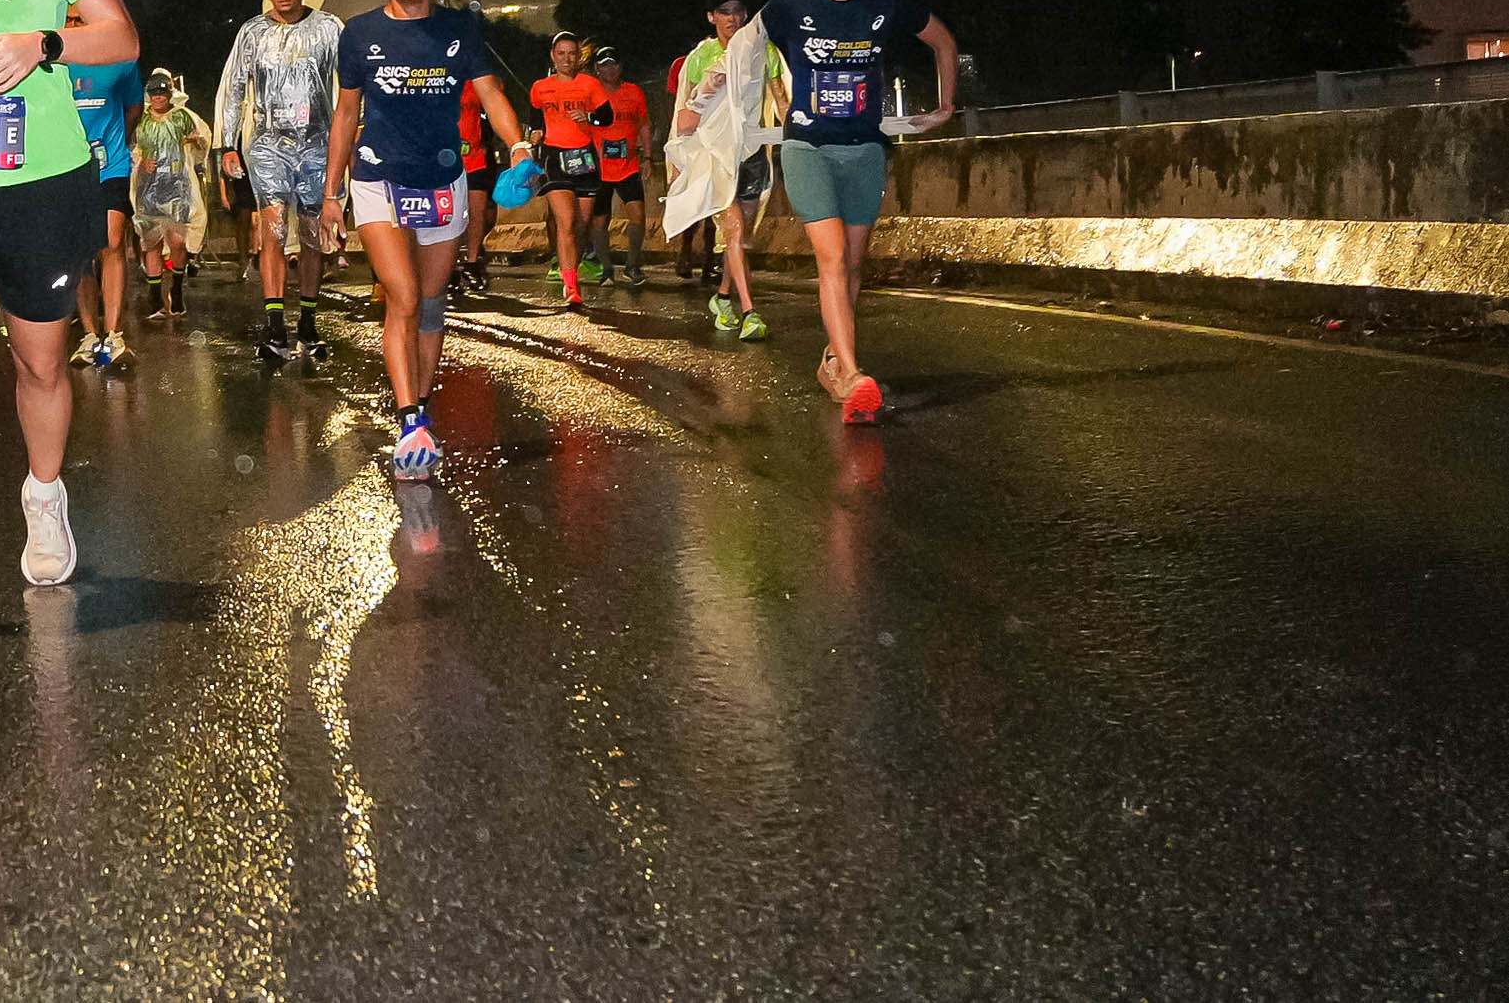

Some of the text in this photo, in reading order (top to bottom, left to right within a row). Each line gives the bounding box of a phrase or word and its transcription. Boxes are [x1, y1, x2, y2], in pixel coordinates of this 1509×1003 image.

[804, 37, 872, 50] ASICS GOLDEN
[375, 66, 447, 78] ASICS GOLDEN
[406, 78, 445, 87] RUN 2026
[396, 87, 415, 95] SÃO
[820, 89, 854, 102] 3558
[7, 127, 18, 144] E
[7, 154, 15, 165] F
[400, 197, 449, 211] 2774 C
